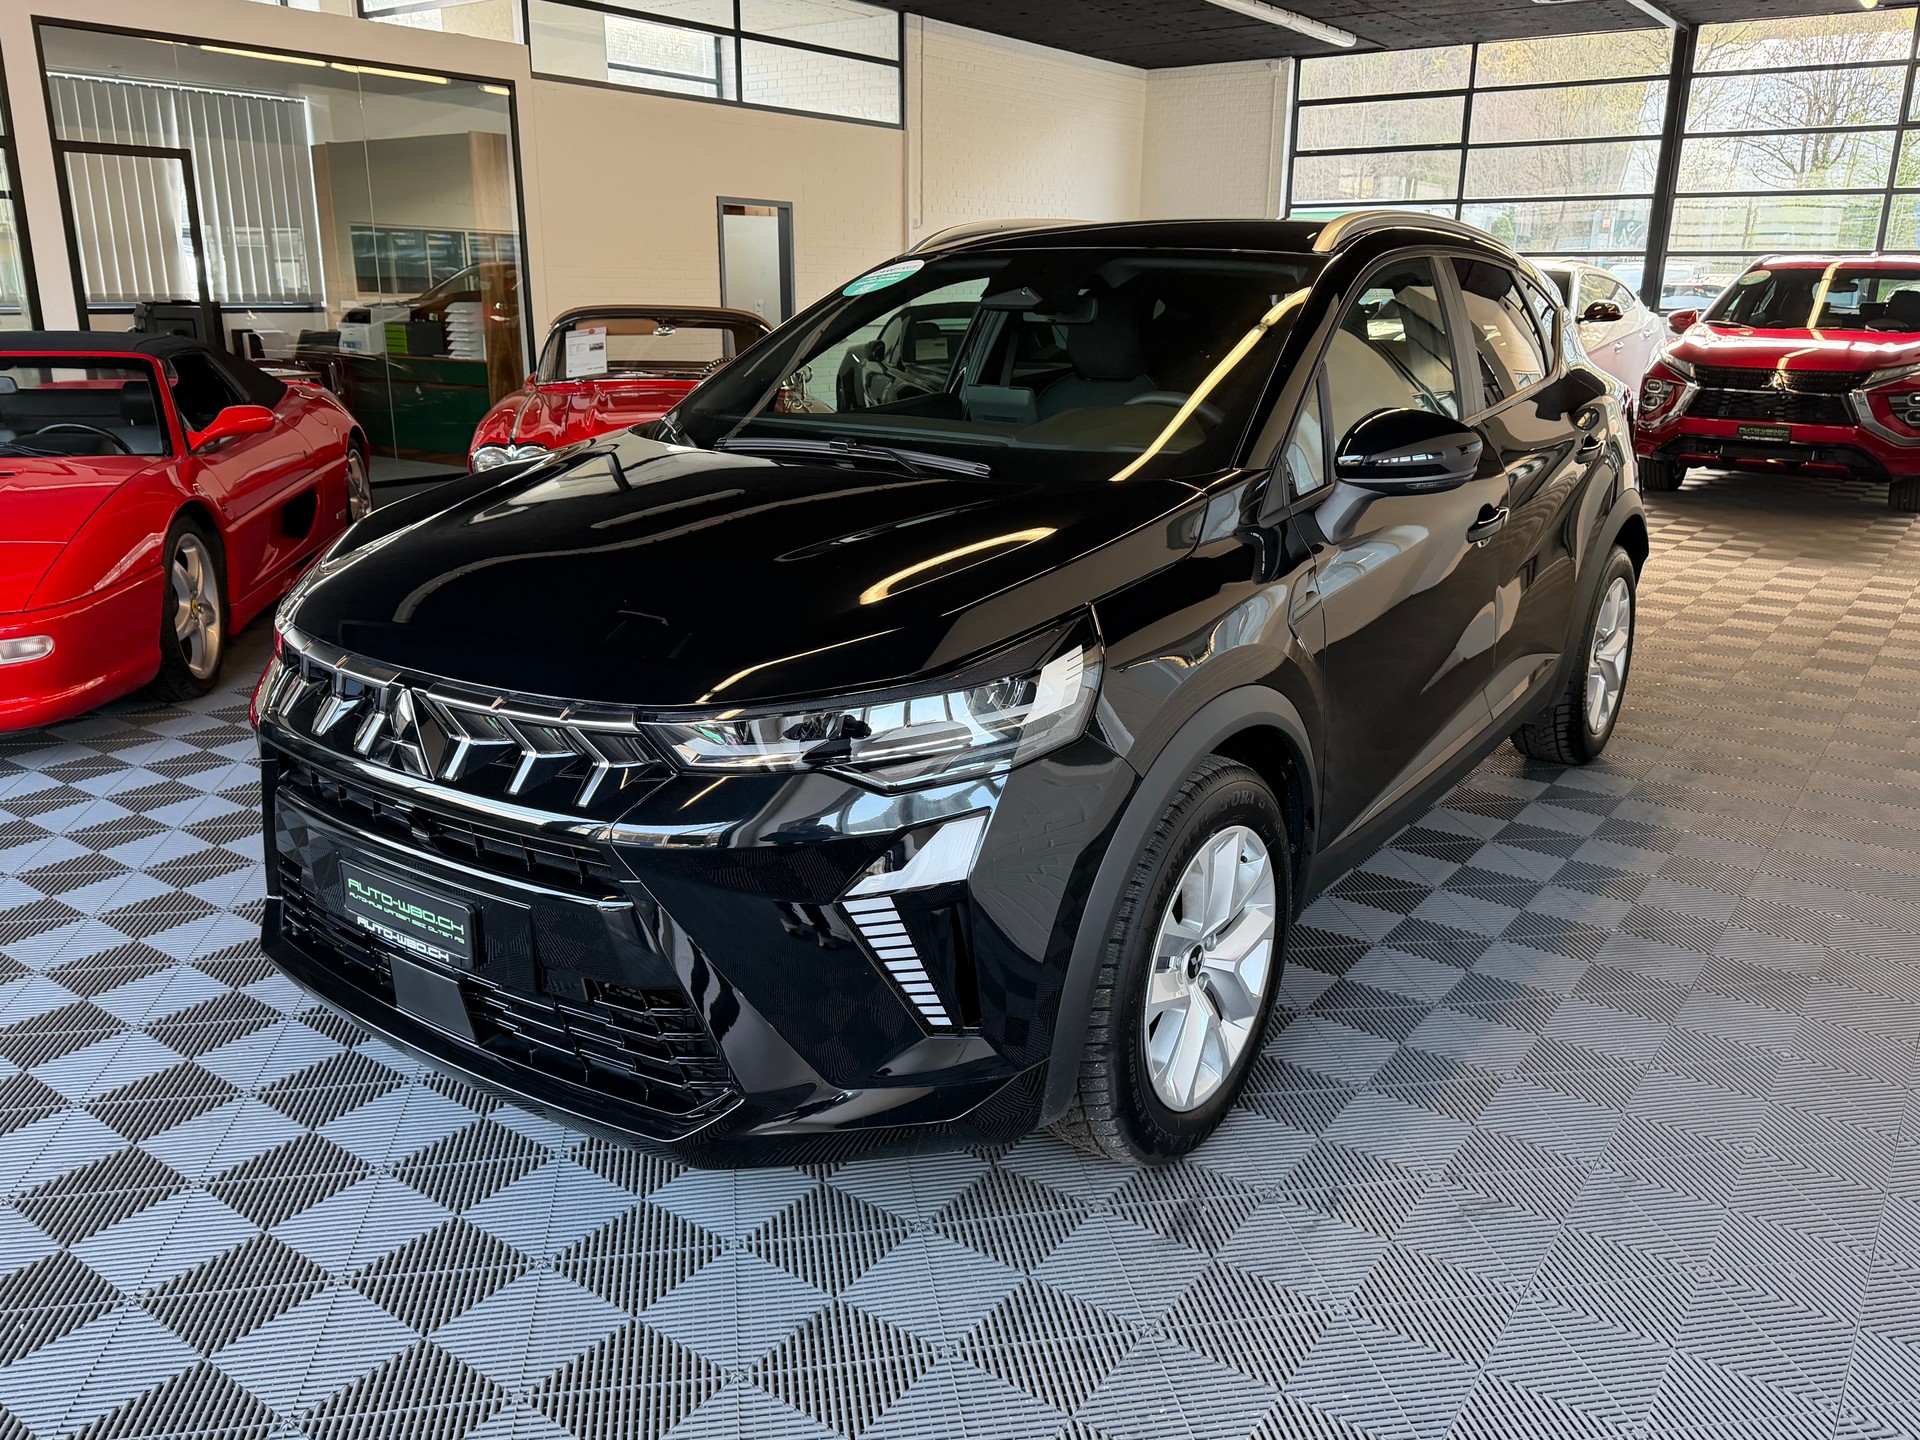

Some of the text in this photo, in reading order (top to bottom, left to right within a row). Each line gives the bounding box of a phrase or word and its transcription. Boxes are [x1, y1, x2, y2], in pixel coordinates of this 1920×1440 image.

[348, 878, 464, 935] AUTO-WBO.CH
[357, 916, 450, 961] AUTO-WBO.CH
[428, 926, 453, 938] OLTEN
